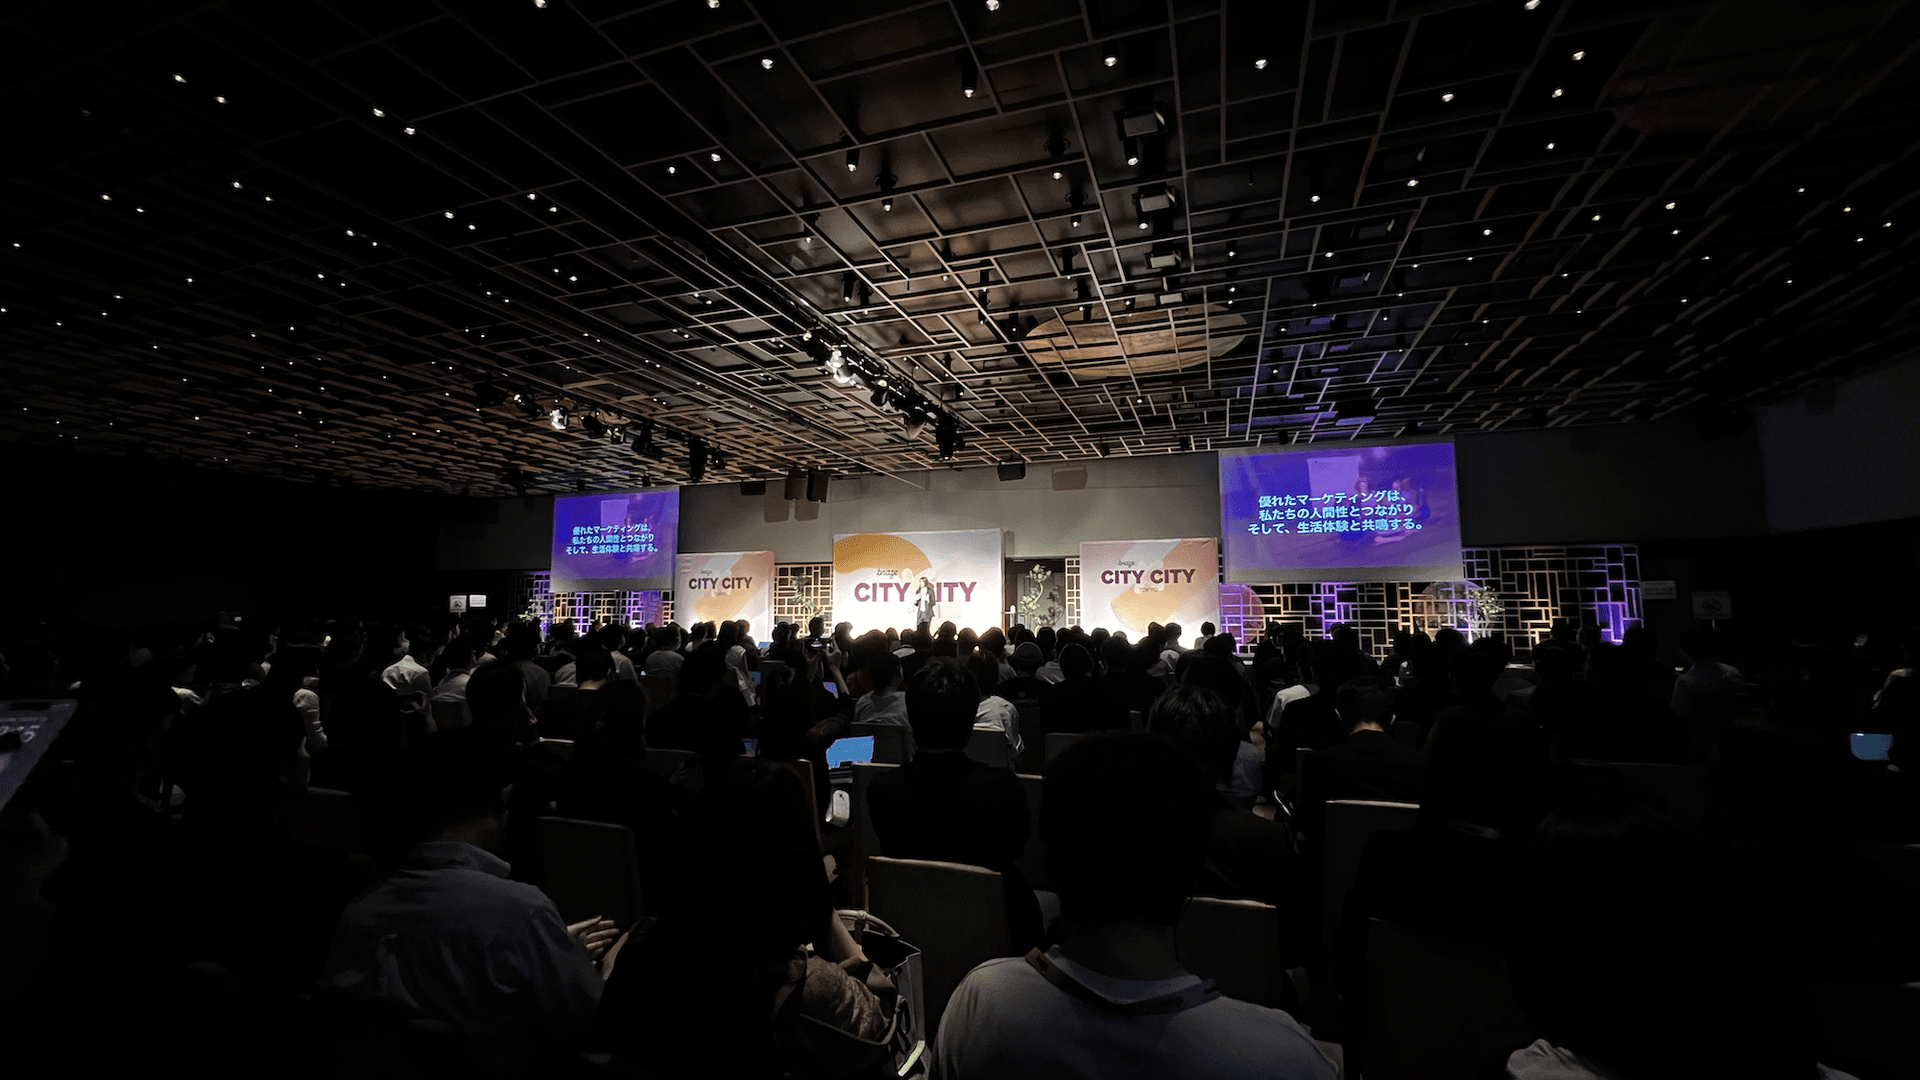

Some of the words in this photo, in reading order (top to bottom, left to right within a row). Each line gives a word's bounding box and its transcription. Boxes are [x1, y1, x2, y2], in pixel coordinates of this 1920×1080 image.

[1258, 490, 1406, 508] 優れたマーケティングは、
[1258, 504, 1414, 521] 私たちの人間性とつながり
[1247, 518, 1423, 535] そして、生活体験と共鳴する。
[688, 577, 719, 590] CITY
[721, 577, 753, 590] CITY
[1100, 570, 1145, 584] CITY
[1149, 569, 1196, 584] CITY
[854, 582, 911, 602] CITY
[928, 581, 977, 602] ITY
